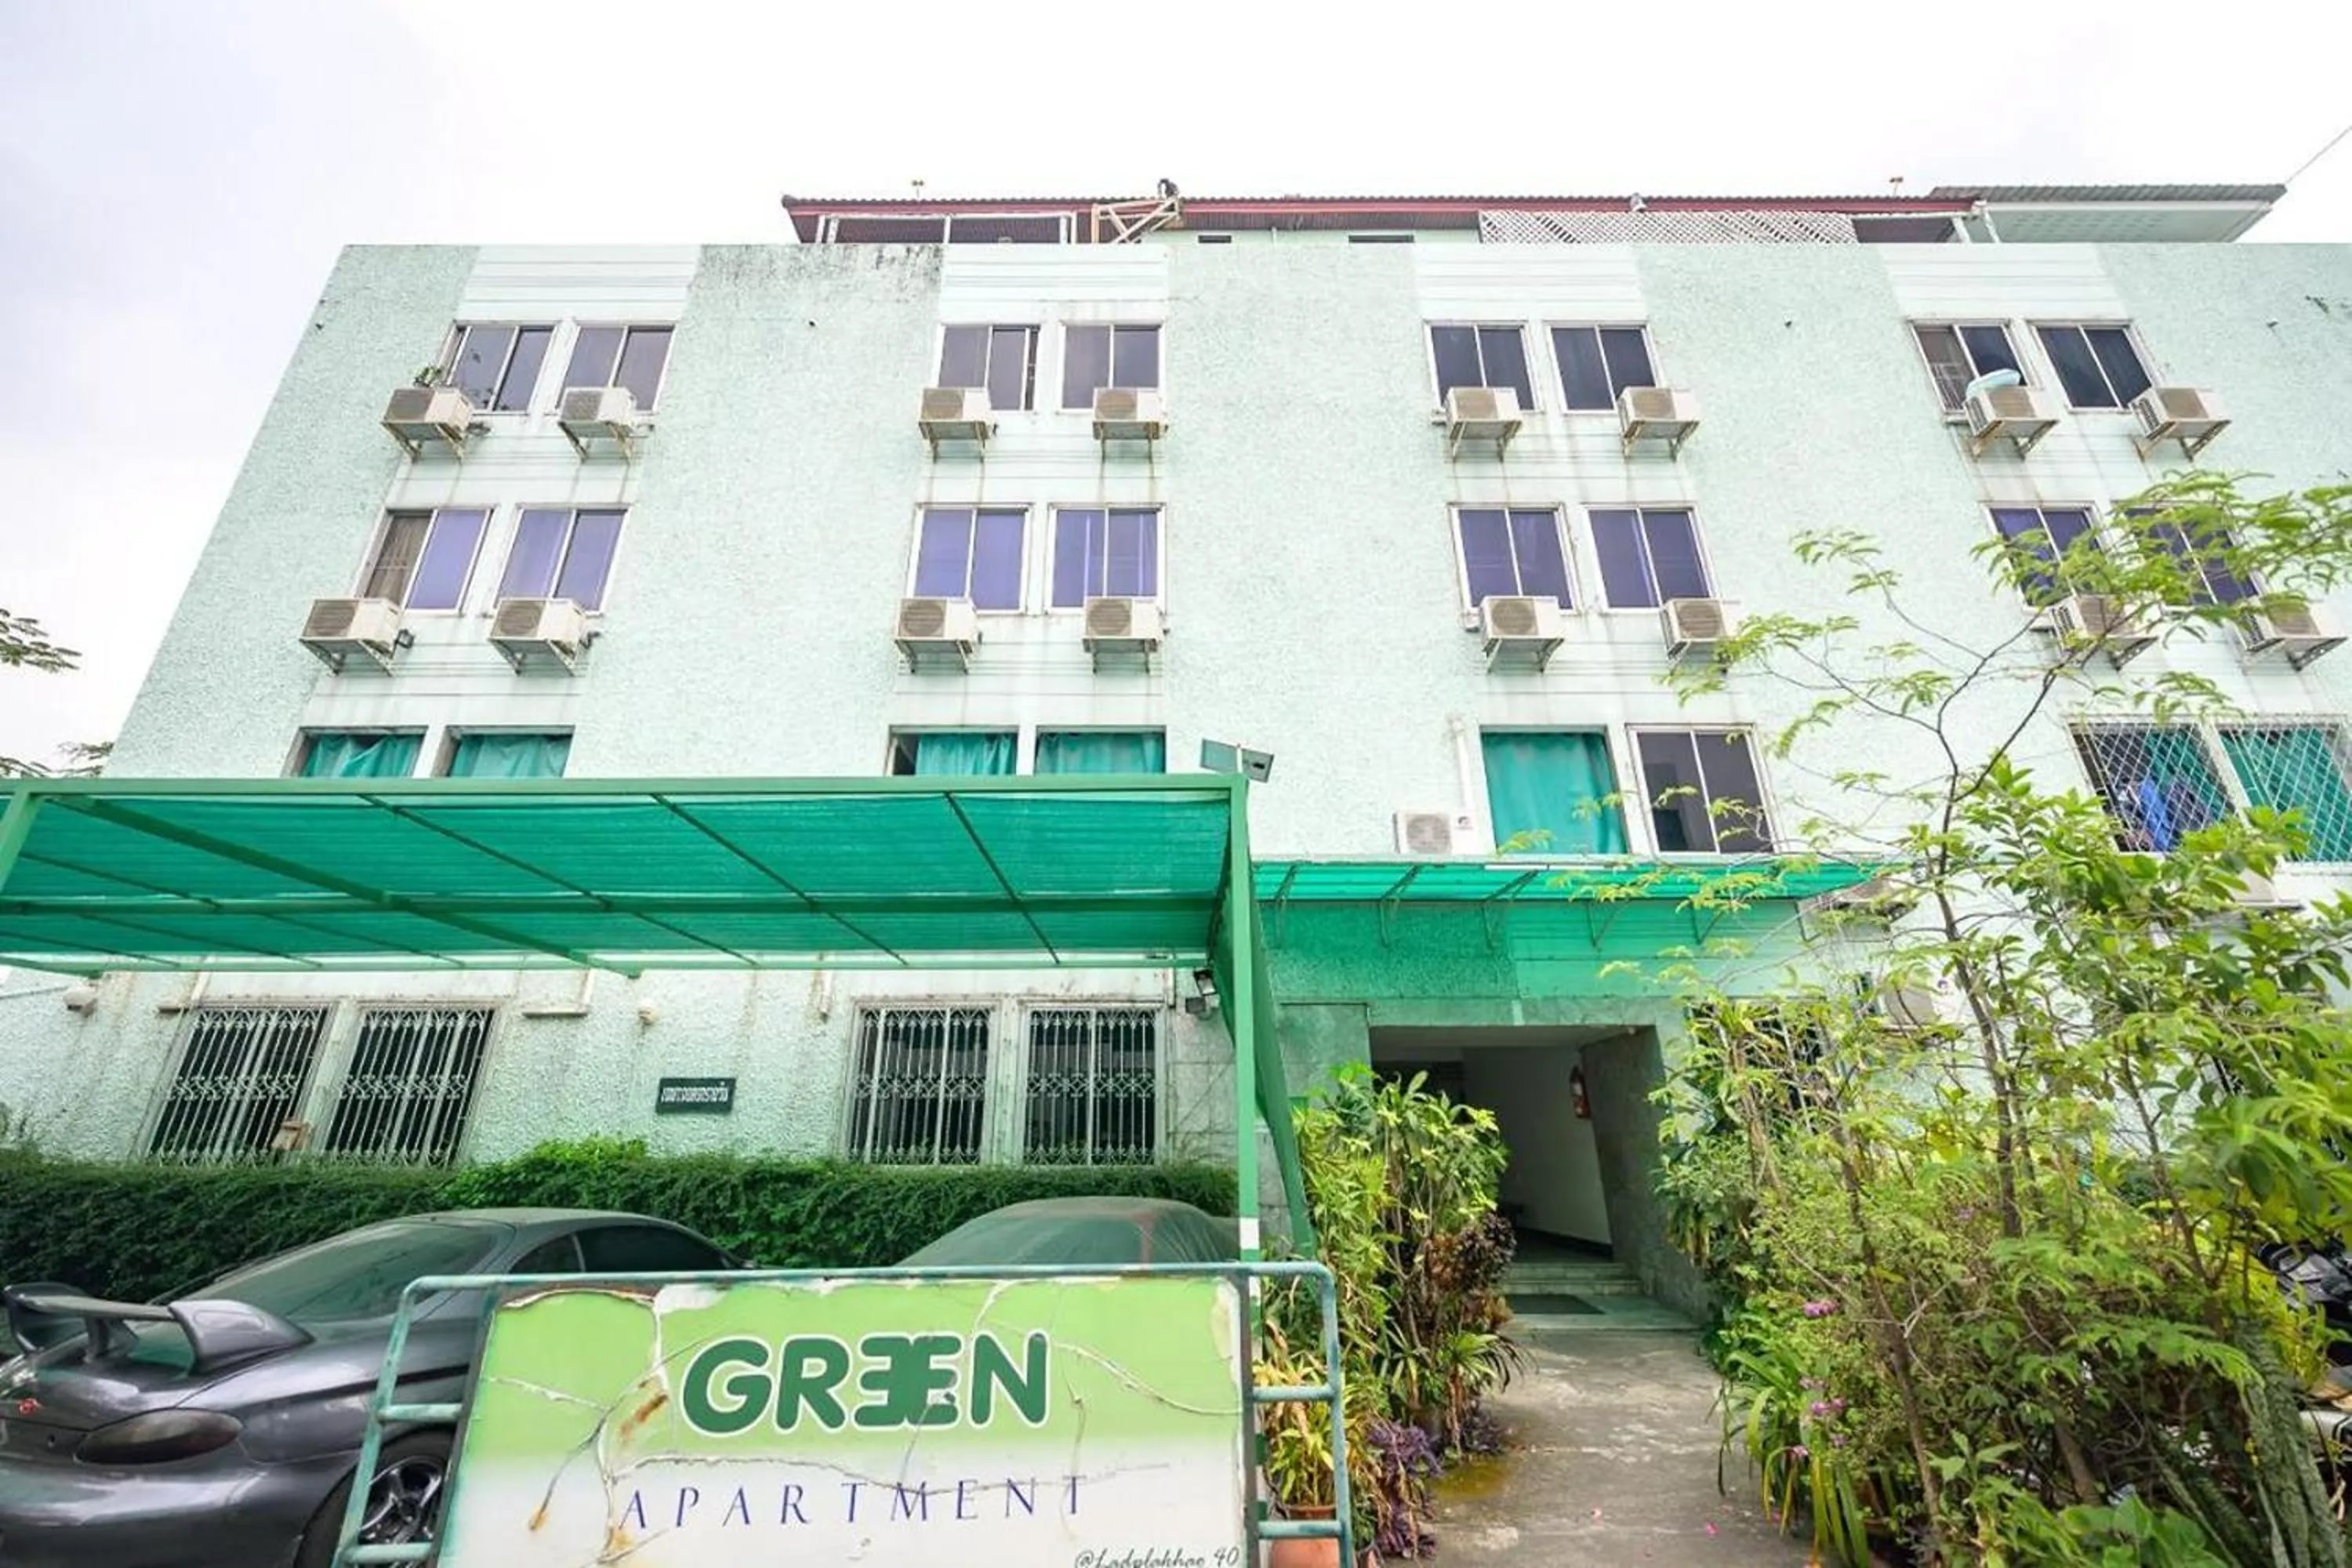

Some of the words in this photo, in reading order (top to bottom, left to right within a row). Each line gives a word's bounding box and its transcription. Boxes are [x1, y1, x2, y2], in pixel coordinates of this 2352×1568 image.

[681, 1331, 1048, 1434] GREEN
[618, 1475, 1087, 1530] APARTMENT
[1214, 1546, 1240, 1566] 40
